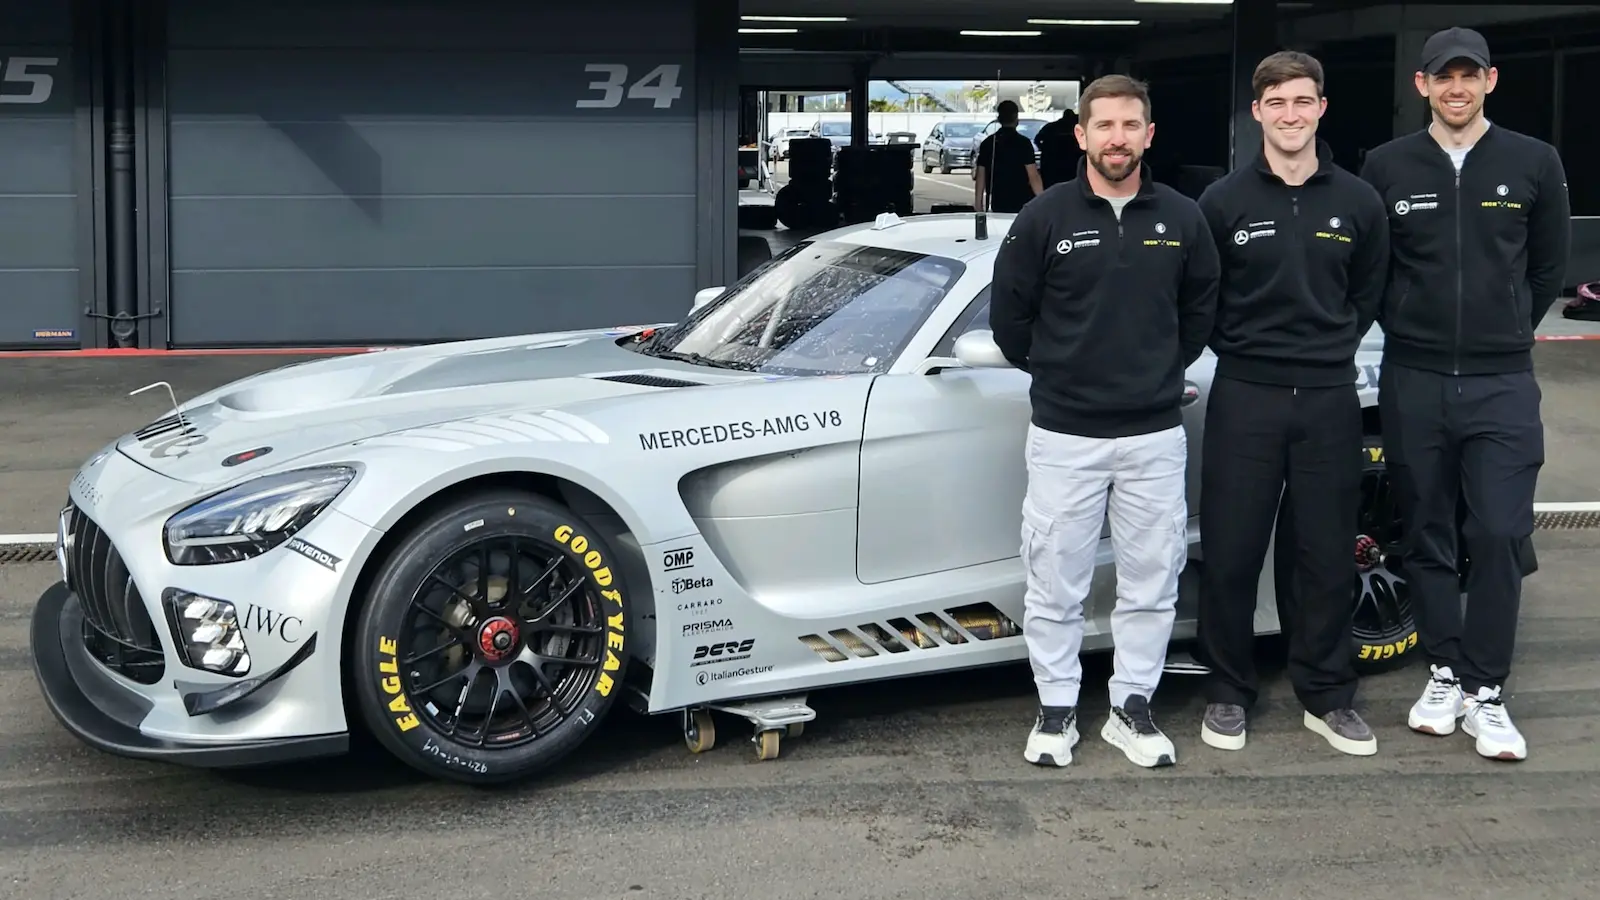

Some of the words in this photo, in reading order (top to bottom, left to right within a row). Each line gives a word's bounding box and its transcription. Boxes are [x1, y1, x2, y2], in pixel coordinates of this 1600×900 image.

[0, 56, 59, 104] 5
[576, 63, 683, 109] 34
[639, 414, 810, 451] MERCEDES-AMG
[813, 410, 842, 429] V8
[663, 550, 695, 568] OMP
[677, 598, 723, 611] CARRARO
[243, 602, 304, 643] IWC
[682, 618, 733, 633] PRISMA
[1357, 631, 1418, 660] EAGLE
[379, 635, 421, 732] EAGLE
[710, 665, 774, 681] ItalianGesture
[573, 708, 595, 726] FL
